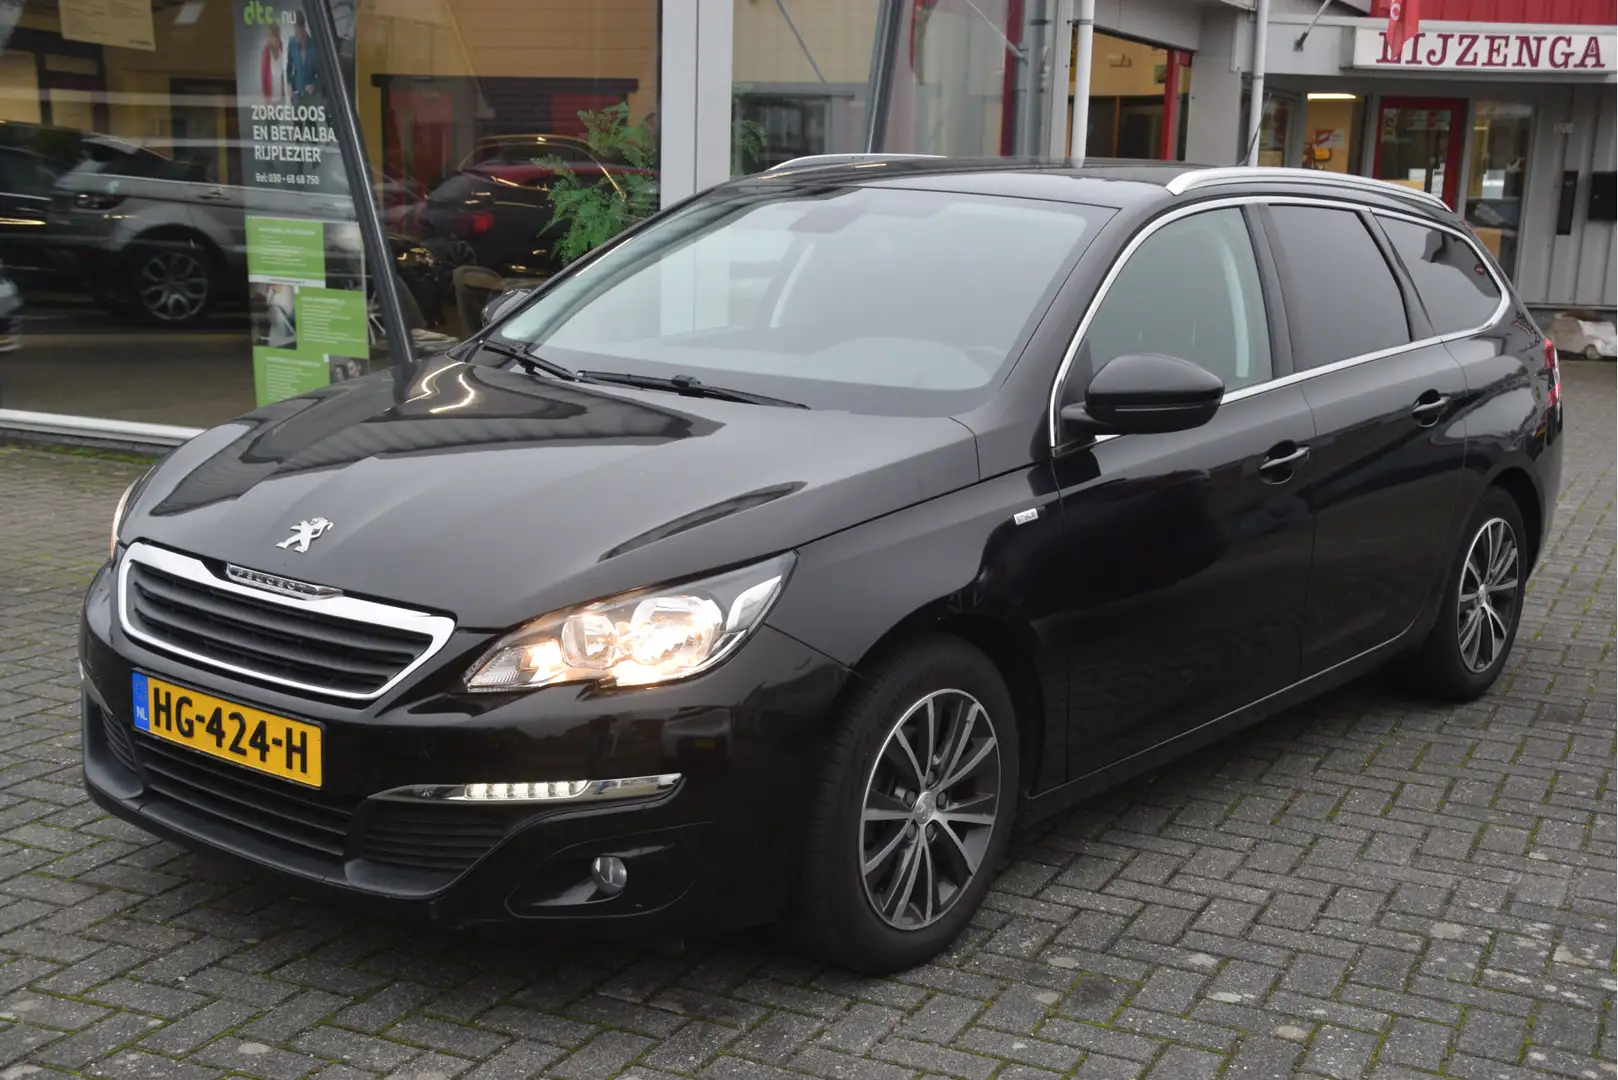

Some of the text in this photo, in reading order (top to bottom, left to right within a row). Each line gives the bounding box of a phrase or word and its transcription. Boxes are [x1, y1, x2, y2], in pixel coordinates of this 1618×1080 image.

[251, 105, 326, 121] ZORGELOOS
[253, 126, 338, 143] EN BETAALBA
[254, 145, 321, 162] RIJPLEZIER
[136, 707, 148, 721] NL
[153, 687, 307, 774] HG-424-H
